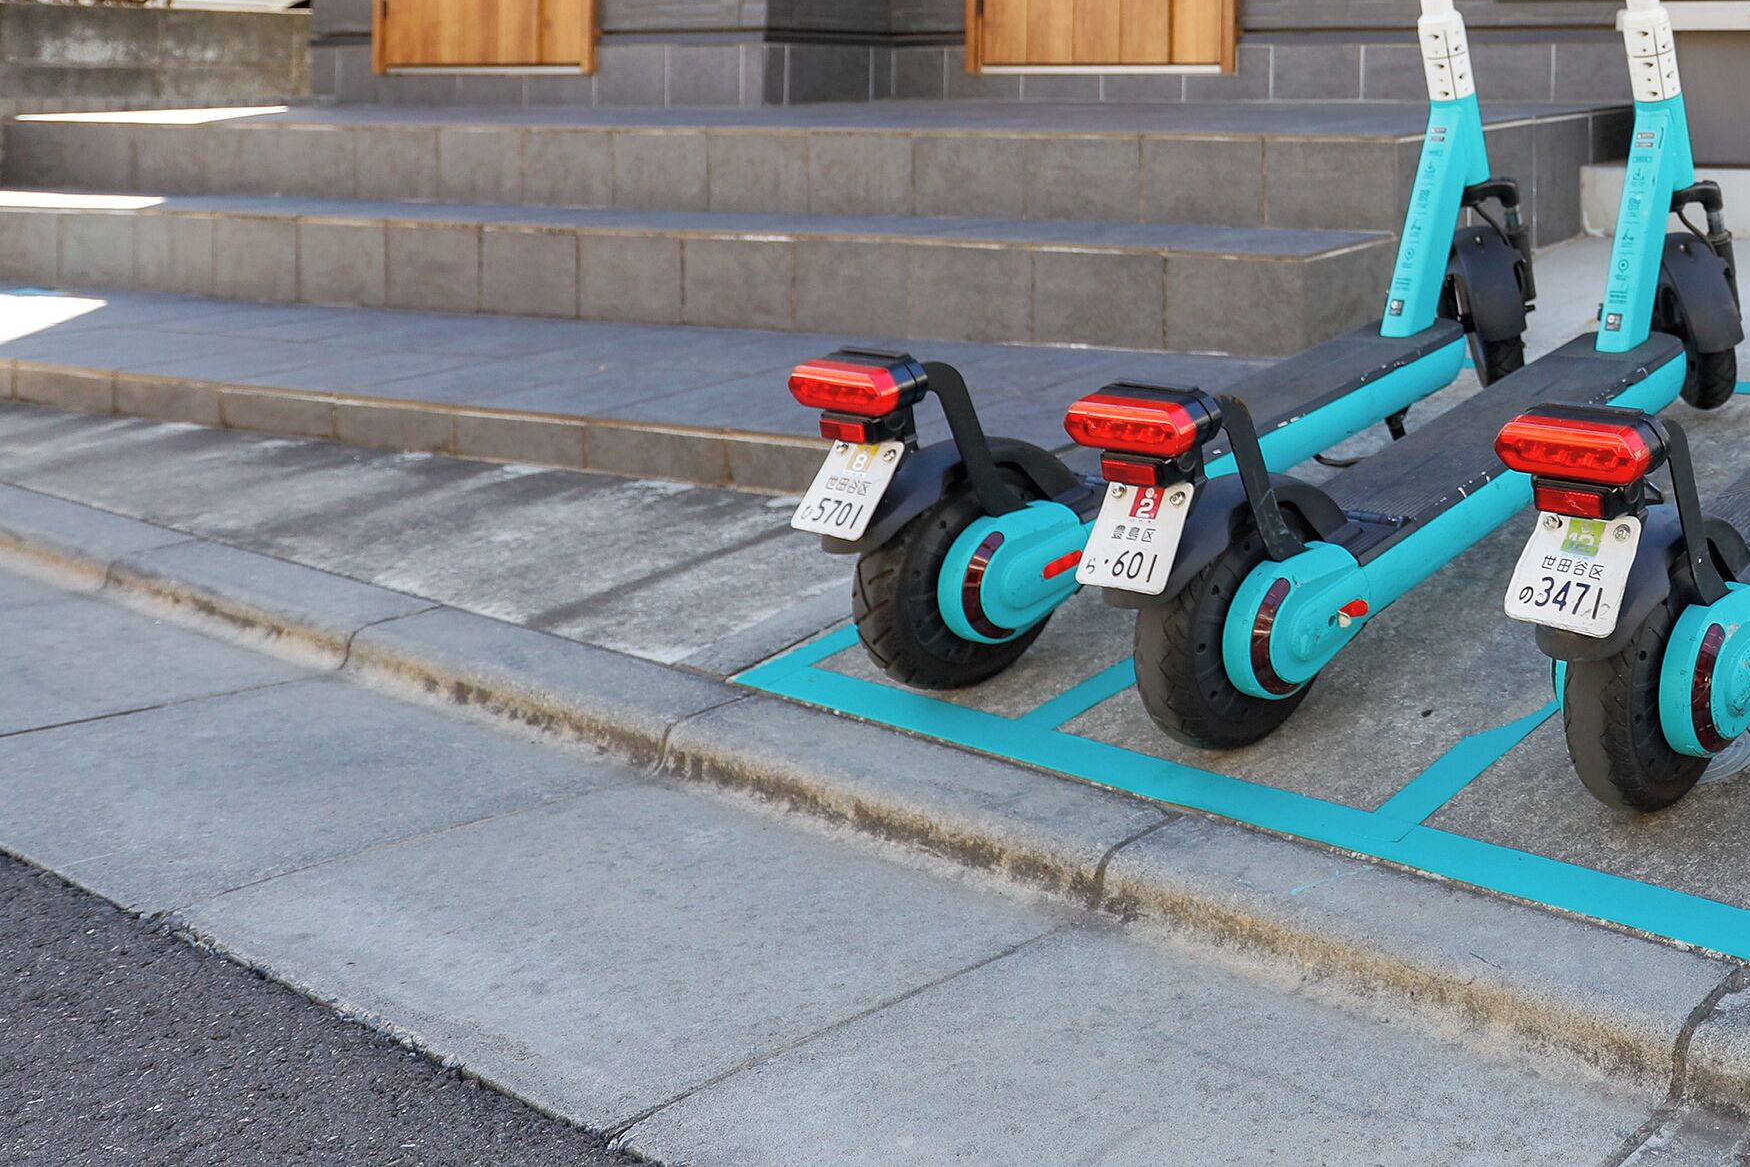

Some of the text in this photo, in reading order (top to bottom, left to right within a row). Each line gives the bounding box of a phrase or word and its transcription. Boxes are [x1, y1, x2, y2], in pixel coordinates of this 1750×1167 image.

[852, 453, 868, 471] 8
[812, 497, 864, 530] 5701
[1136, 498, 1154, 519] 2
[1541, 555, 1605, 580] 世田谷区
[1534, 576, 1604, 620] 3471
